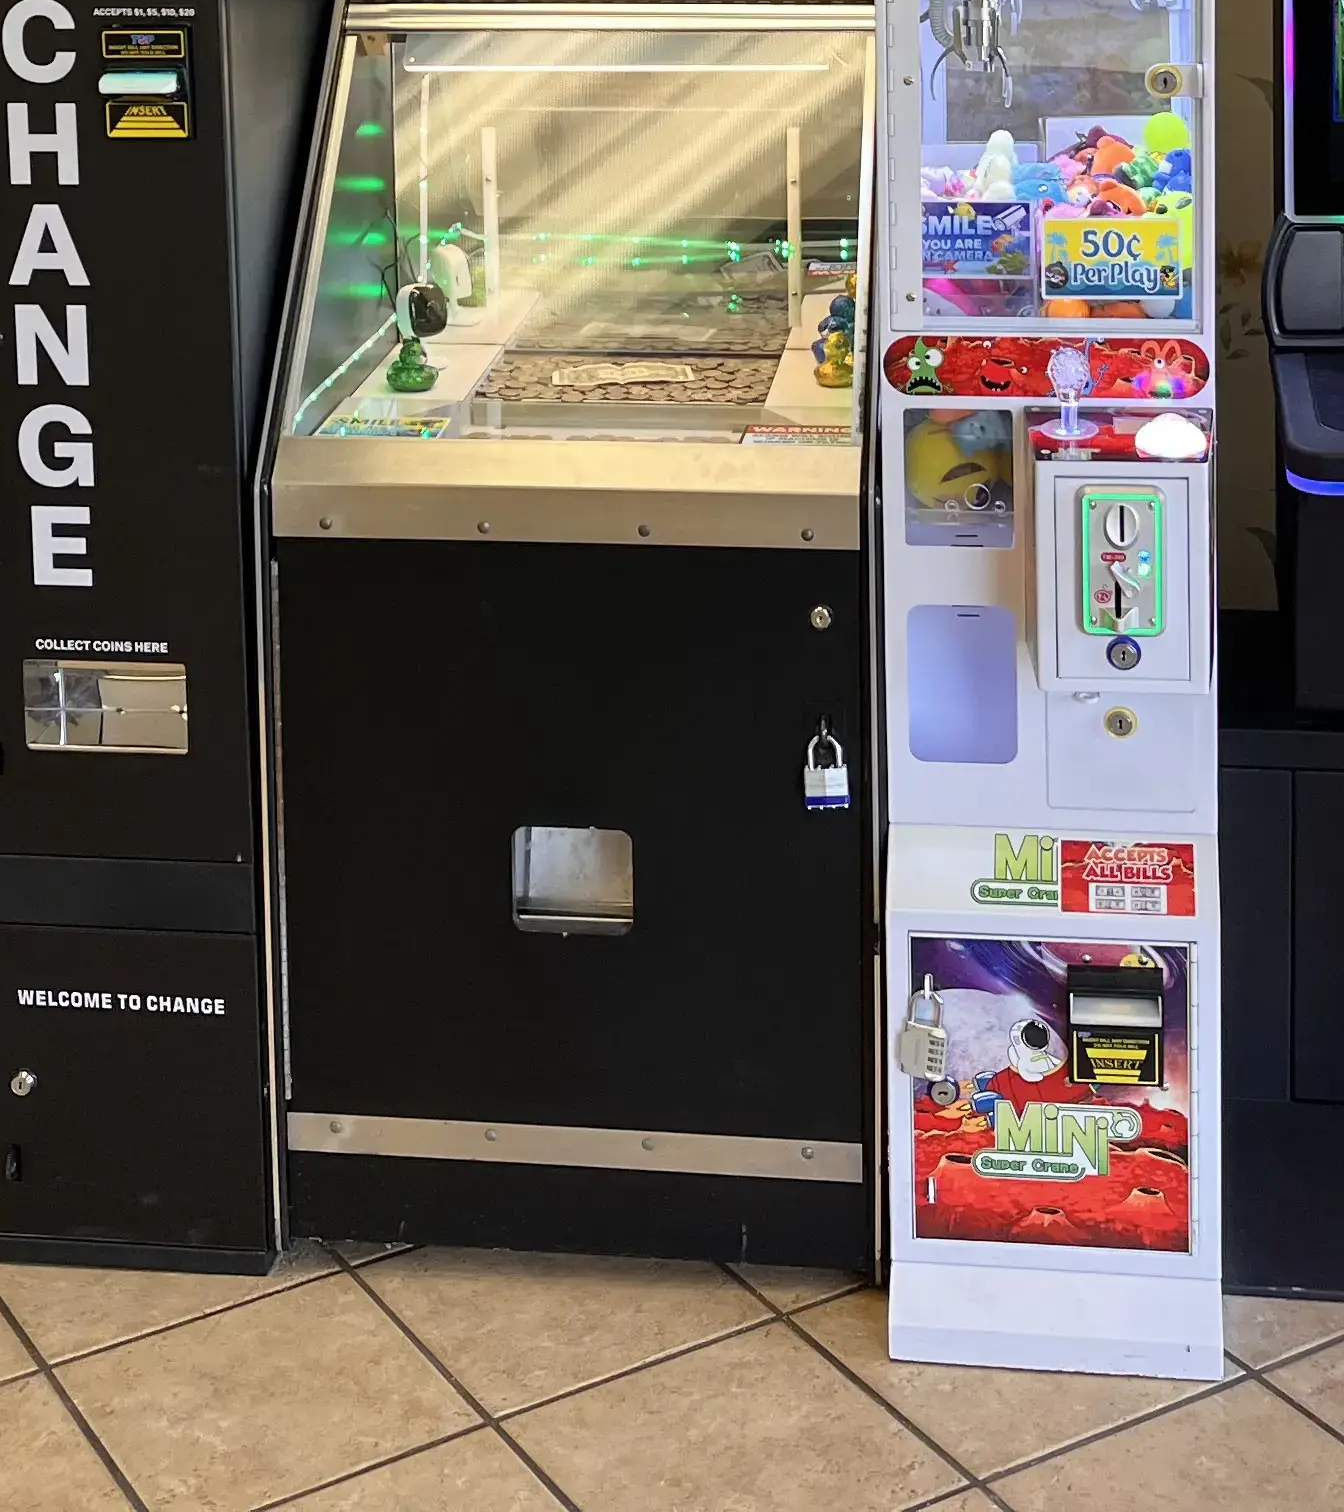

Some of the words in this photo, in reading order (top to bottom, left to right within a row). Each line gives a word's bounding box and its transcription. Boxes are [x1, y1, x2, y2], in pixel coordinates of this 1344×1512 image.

[93, 7, 133, 17] ACCEPTS
[178, 8, 196, 17] $20
[123, 105, 168, 116] INSERT
[922, 238, 952, 250] YOU
[954, 238, 983, 250] ARE
[1080, 228, 1142, 260] 50¢
[934, 250, 994, 262] CAMERA
[1071, 263, 1107, 287] Per
[1109, 263, 1162, 293] Play
[35, 638, 91, 651] COLLECT
[93, 640, 133, 653] COINS
[134, 641, 169, 654] HERE
[994, 833, 1055, 881] Mi
[1084, 843, 1168, 864] ACCEPTS
[1082, 862, 1121, 881] ALL
[1121, 863, 1174, 883] BILLS
[978, 885, 1024, 900] Super
[17, 989, 113, 1009] WELCOME
[117, 993, 142, 1011] TO
[146, 995, 226, 1016] CHANGE
[1089, 1058, 1144, 1070] INSERT
[980, 1155, 1028, 1172] Super
[1031, 1158, 1080, 1174] Crane
